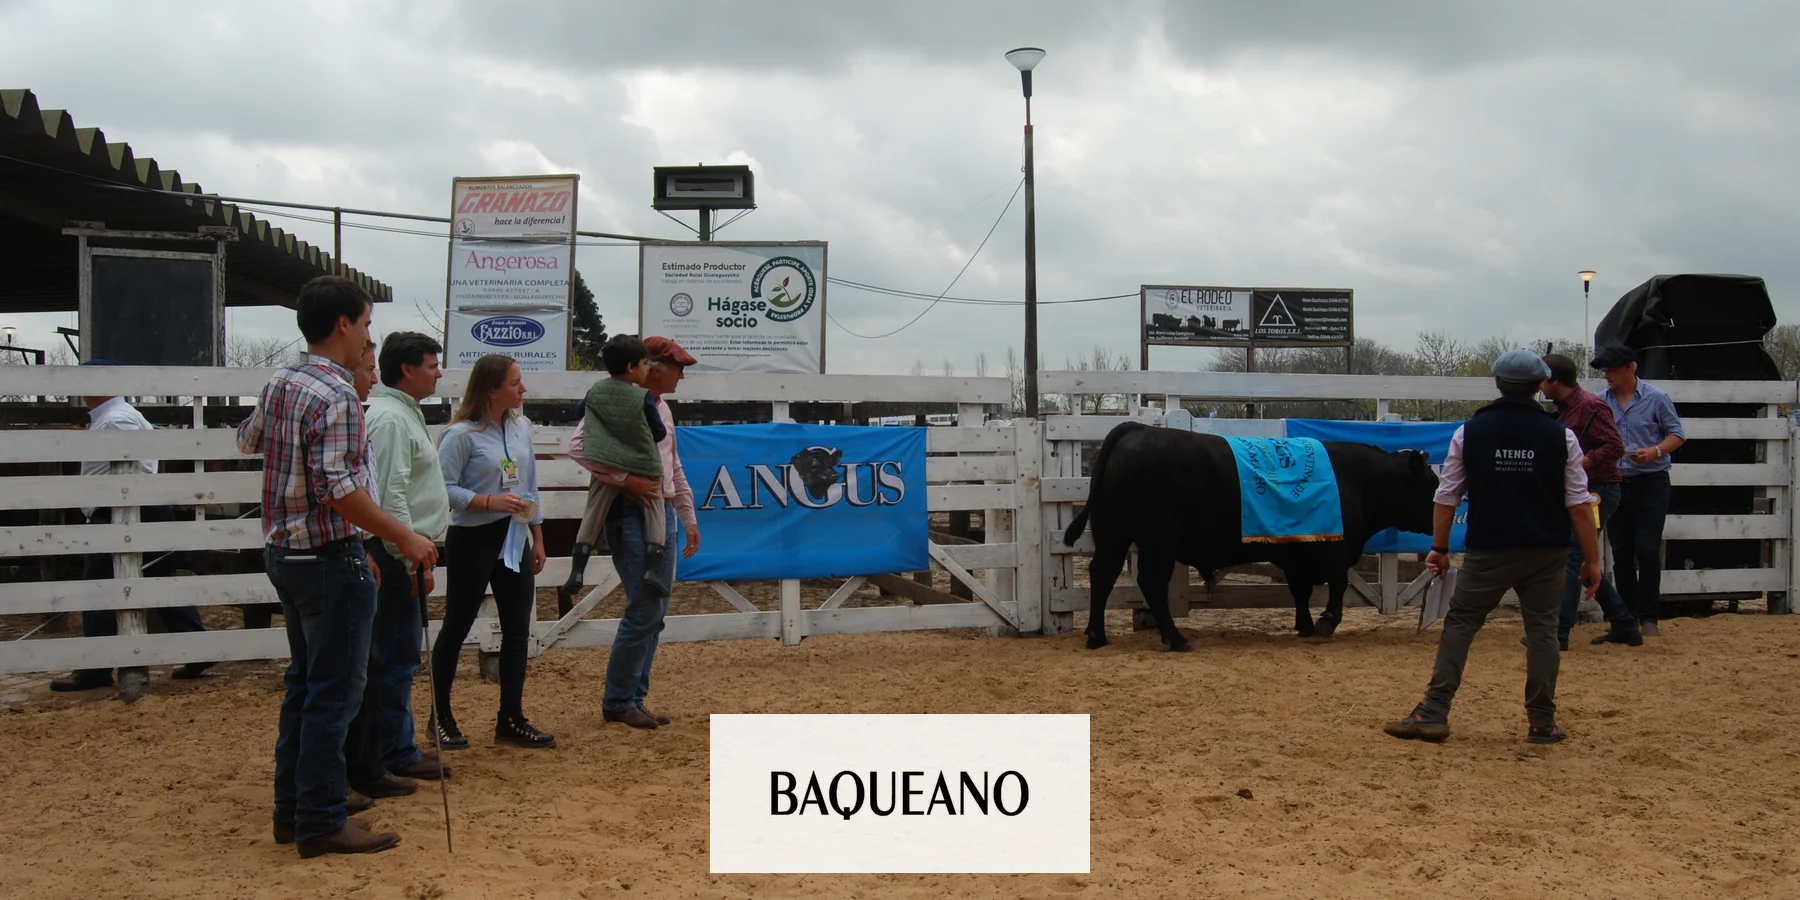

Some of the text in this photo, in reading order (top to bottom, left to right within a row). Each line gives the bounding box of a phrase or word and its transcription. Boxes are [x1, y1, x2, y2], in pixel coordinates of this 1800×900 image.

[457, 190, 572, 214] GRANAZO
[494, 217, 512, 225] hace
[514, 216, 520, 225] la
[465, 250, 558, 275] Angerosa
[662, 262, 746, 270] Estimado Productor
[800, 266, 813, 286] APORTE
[806, 287, 814, 304] IDEAS
[1181, 290, 1232, 305] EL RODEO
[708, 297, 766, 316] Hágase
[716, 316, 758, 328] socio
[1495, 449, 1534, 459] ATENEO
[698, 445, 906, 510] ANGUS
[1248, 452, 1266, 495] MAHO
[1290, 440, 1315, 499] GENTINA DE
